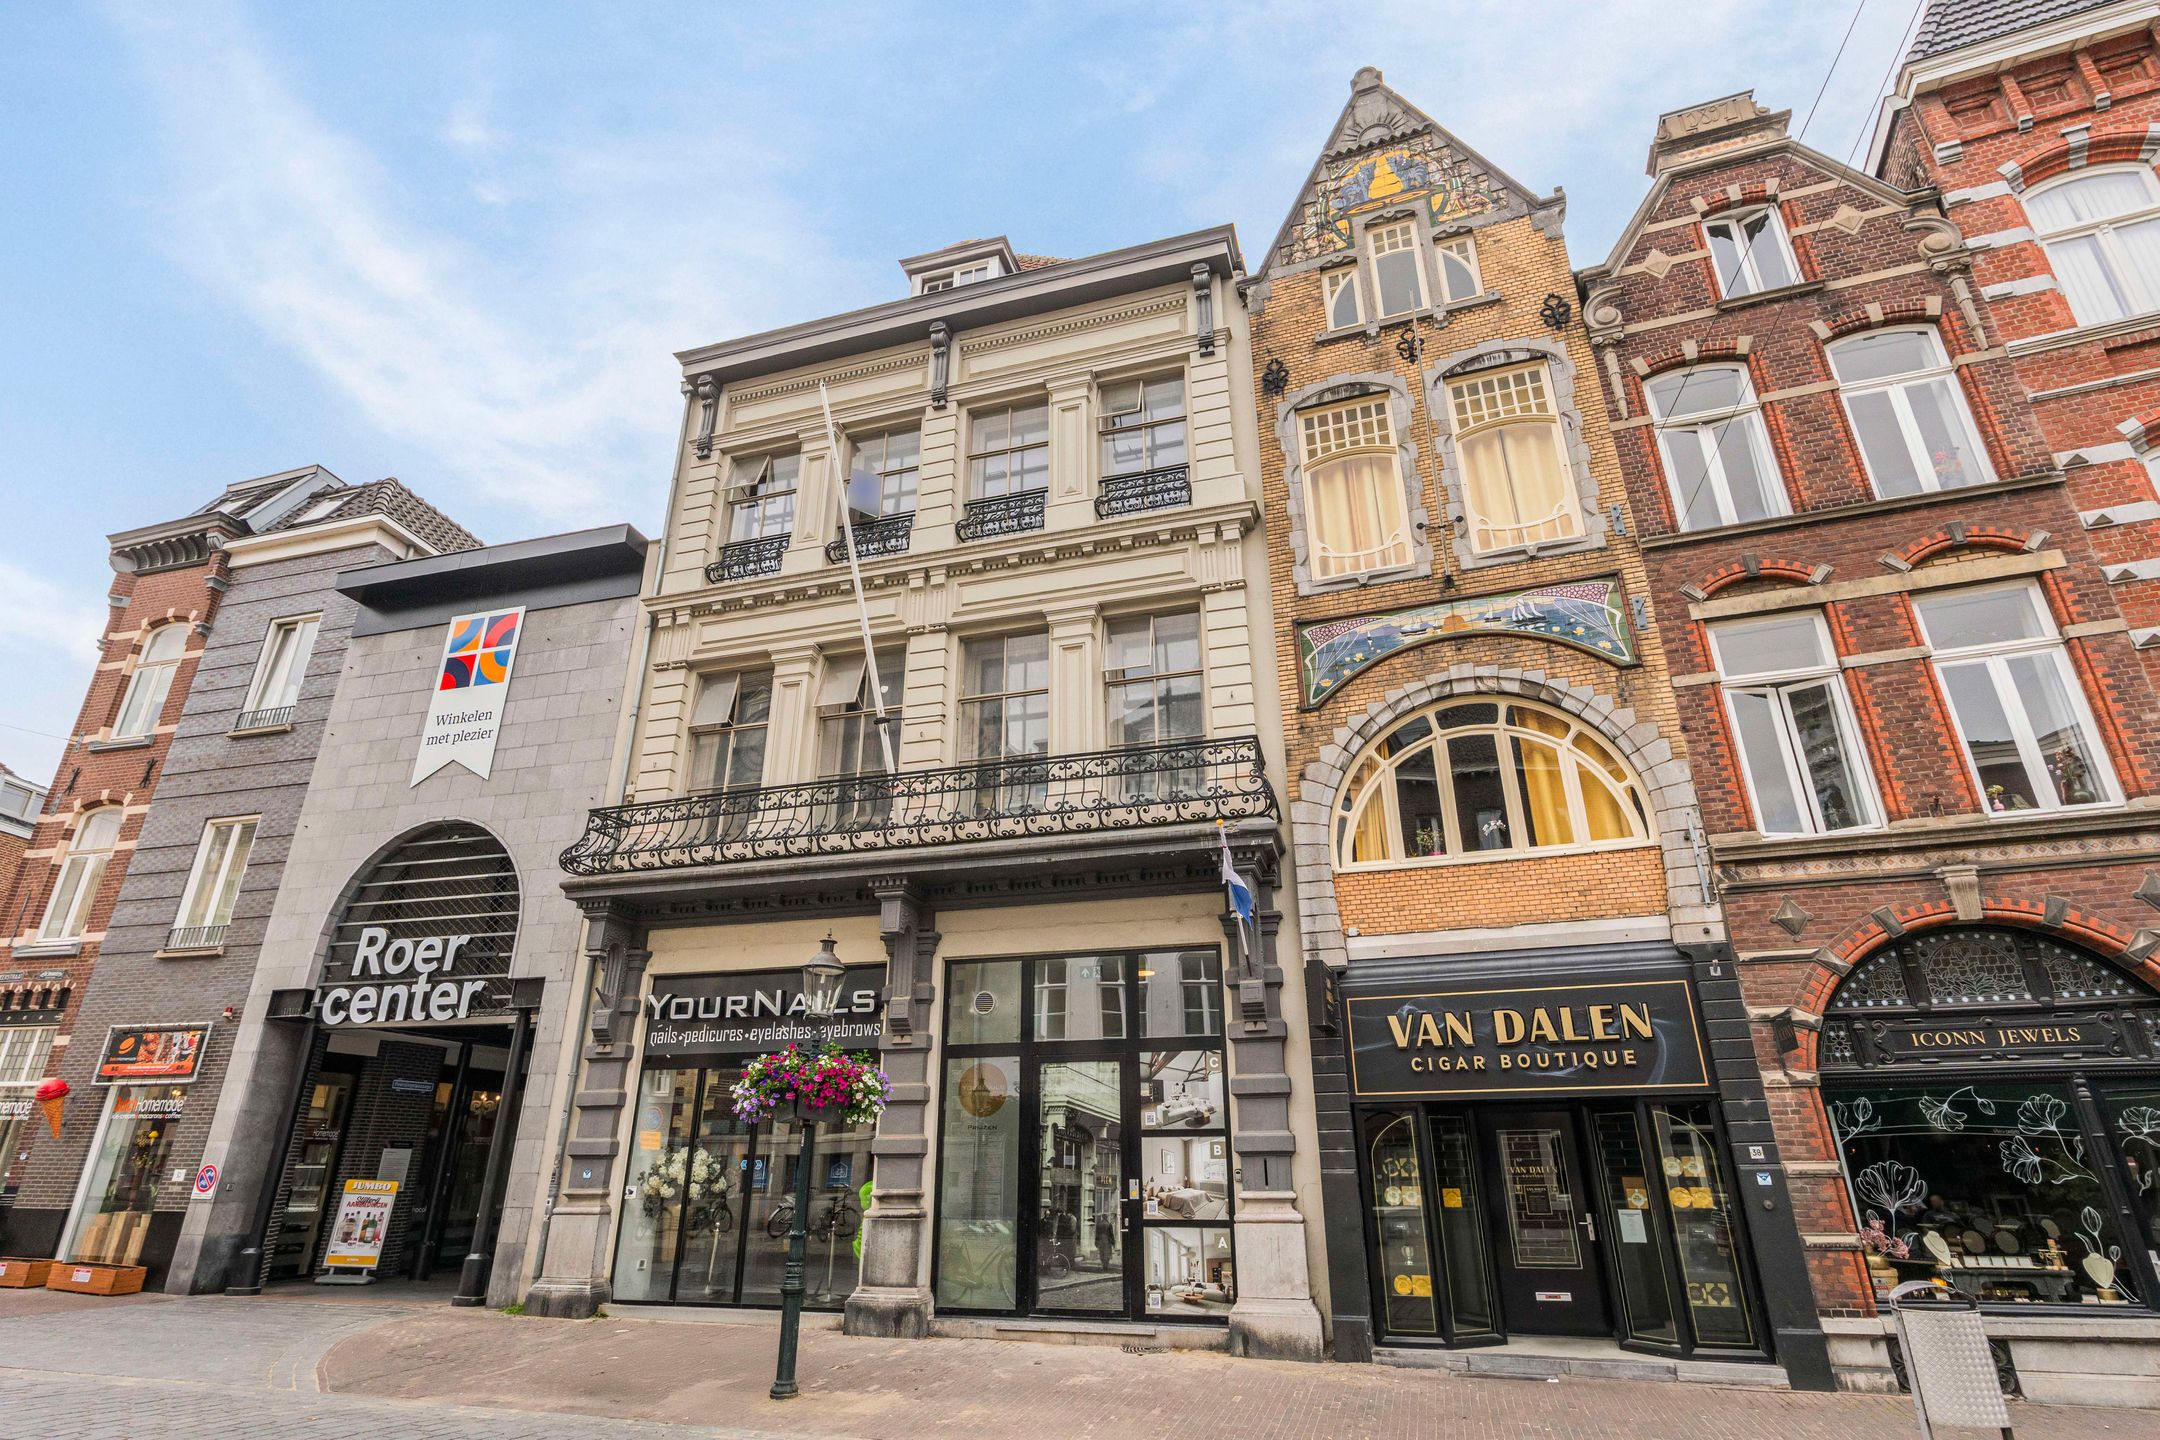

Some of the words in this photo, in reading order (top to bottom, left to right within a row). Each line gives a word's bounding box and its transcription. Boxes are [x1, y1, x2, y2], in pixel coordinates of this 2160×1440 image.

[436, 710, 493, 727] Winkelen
[426, 733, 450, 746] met
[452, 728, 494, 745] plezier
[351, 927, 471, 976] Roer
[322, 971, 487, 1025] center
[1387, 1010, 1475, 1048] VAN
[1493, 1002, 1654, 1045] DALEN
[1911, 1031, 1986, 1047] ICONN
[1998, 1027, 2081, 1047] JEWELS
[1209, 1057, 1219, 1068] C
[1411, 1055, 1486, 1073] CIGAR
[1500, 1050, 1638, 1070] BOUTIQUE
[1213, 1144, 1222, 1156] B
[1752, 1149, 1762, 1157] 38
[351, 1181, 392, 1191] JUMBO
[1217, 1236, 1228, 1249] A
